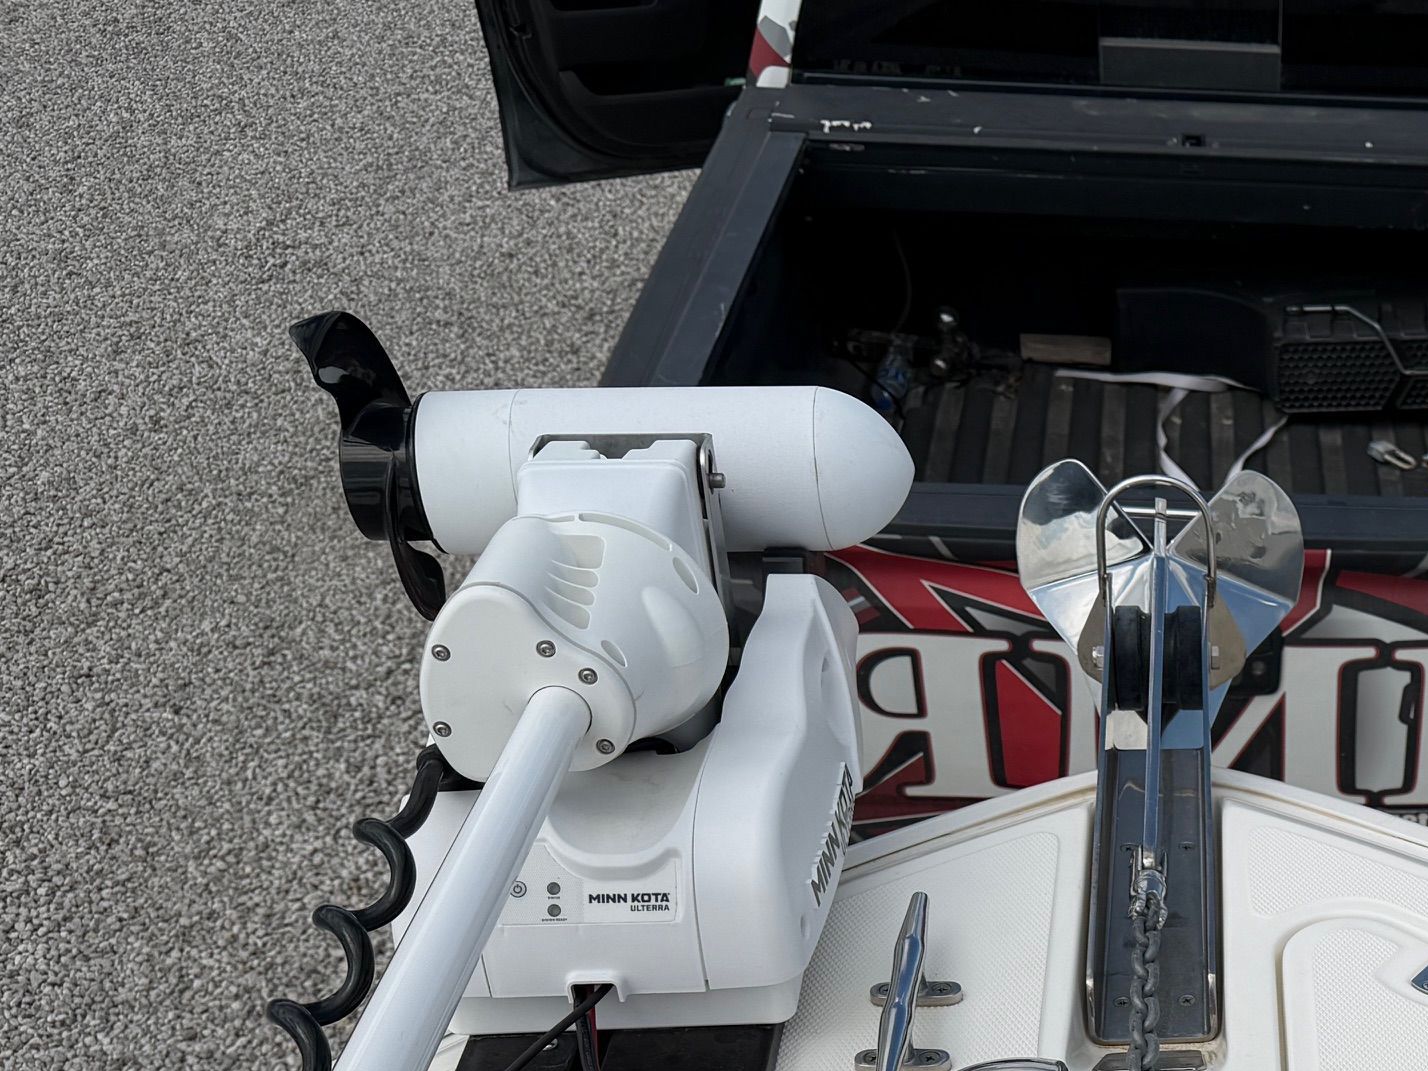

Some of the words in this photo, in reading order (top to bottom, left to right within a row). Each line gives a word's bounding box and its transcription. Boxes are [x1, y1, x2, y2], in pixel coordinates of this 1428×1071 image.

[811, 822, 841, 907] MINN
[588, 893, 628, 904] MINN
[631, 892, 670, 903] KOTA
[630, 904, 670, 912] ULTERRA
